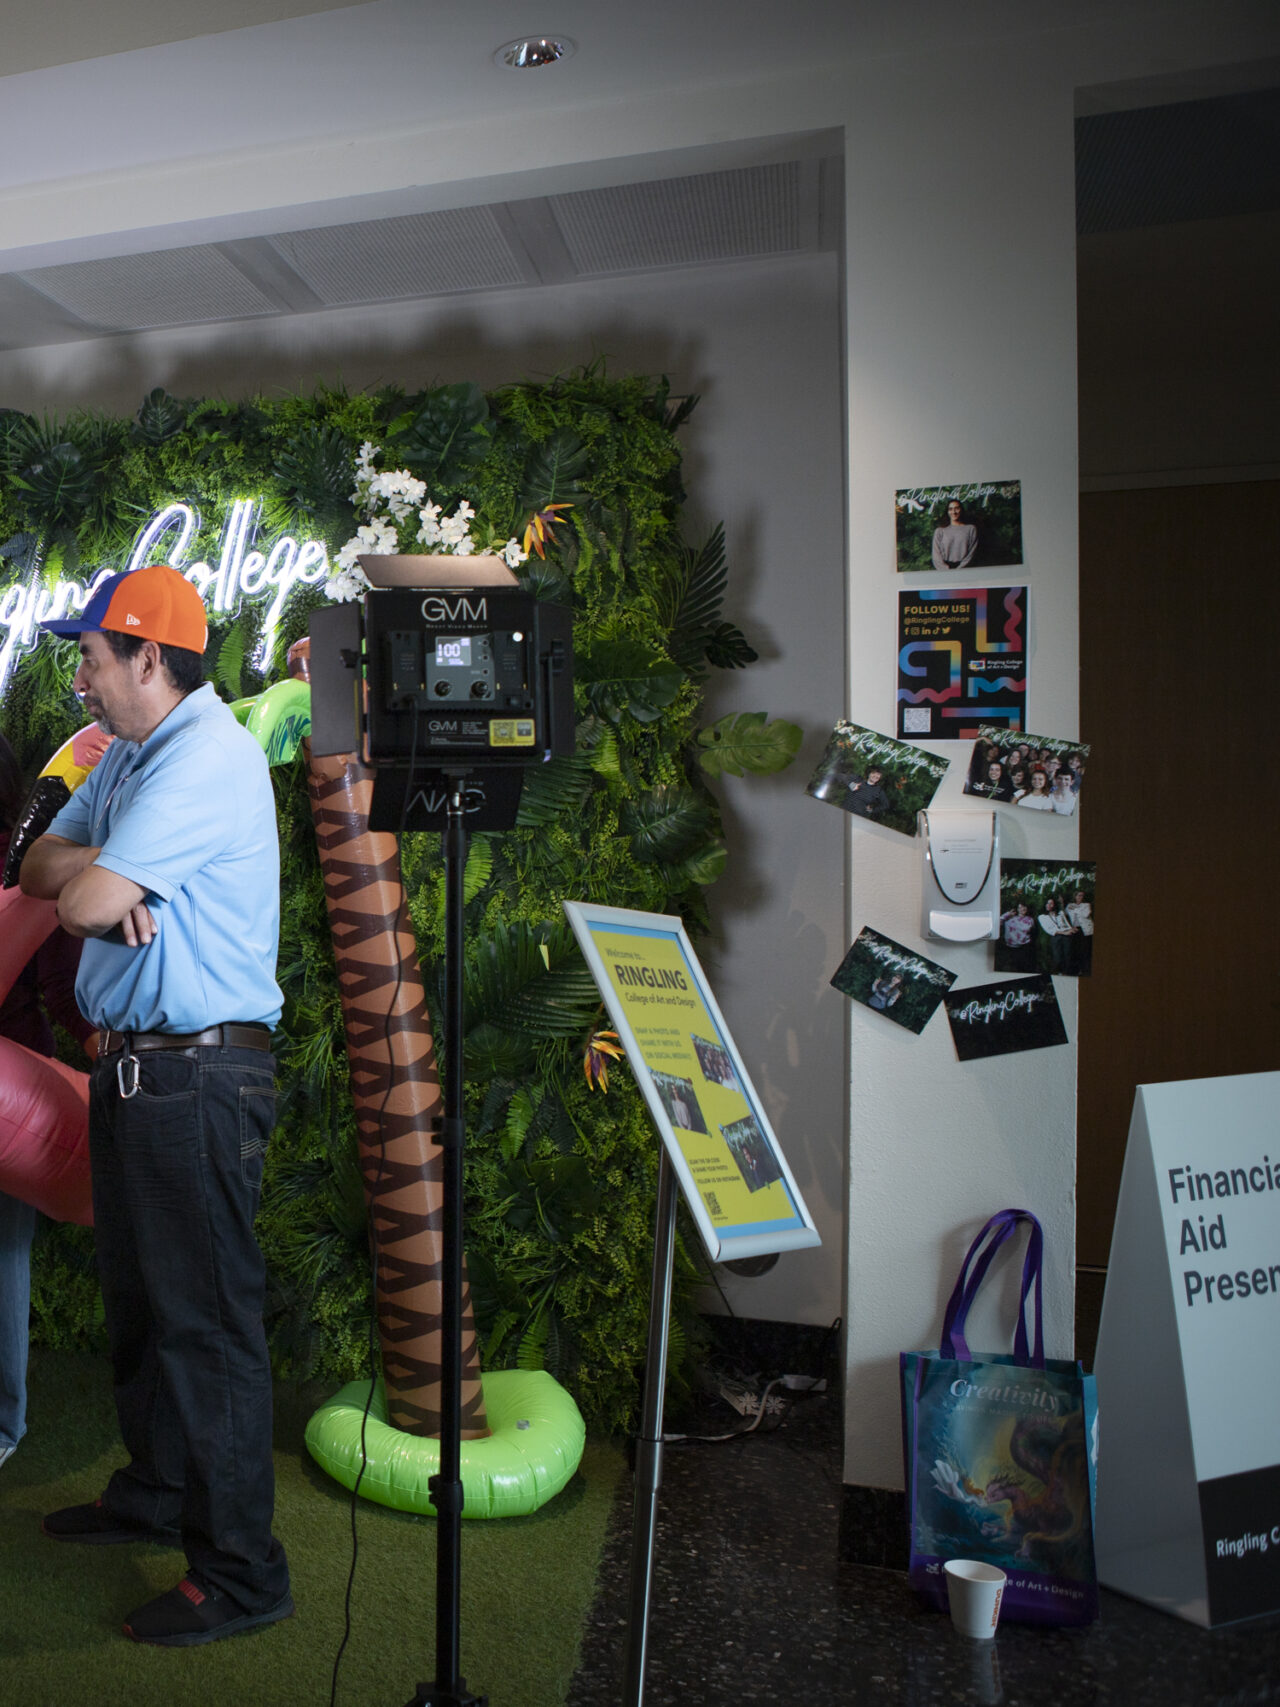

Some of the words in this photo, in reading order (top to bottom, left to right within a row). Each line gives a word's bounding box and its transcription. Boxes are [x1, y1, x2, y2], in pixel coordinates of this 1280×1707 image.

[421, 597, 487, 621] GVM
[904, 605, 949, 615] FOLLOW
[951, 604, 970, 613] US!
[904, 616, 970, 625] @RinglingCollege
[438, 643, 461, 657] 100
[428, 720, 457, 731] GVM
[614, 964, 688, 991] RINGLING
[625, 992, 648, 1005] College
[649, 994, 656, 1003] of
[656, 995, 665, 1004] Art
[666, 996, 676, 1005] and
[676, 996, 695, 1009] Design
[1180, 1214, 1228, 1256] Aid
[950, 1379, 1059, 1412] Creativity
[1216, 1531, 1268, 1558] Ringling
[1016, 1579, 1025, 1588] of
[1028, 1581, 1042, 1591] Art
[1052, 1585, 1084, 1599] Design
